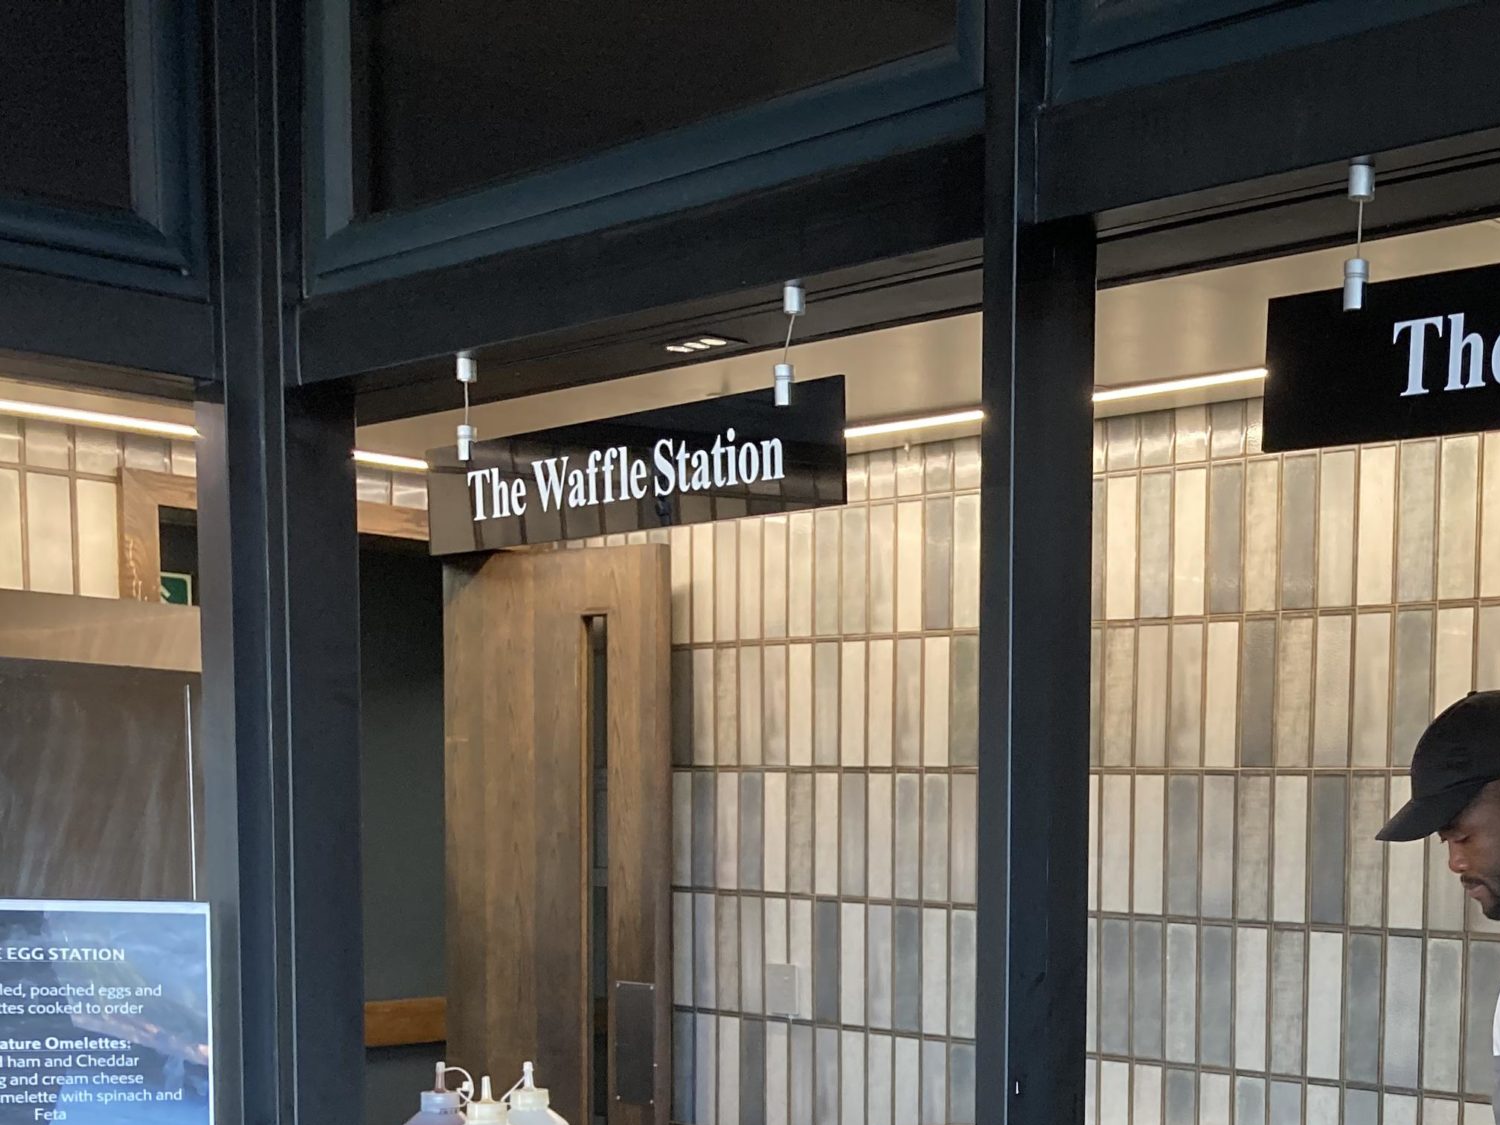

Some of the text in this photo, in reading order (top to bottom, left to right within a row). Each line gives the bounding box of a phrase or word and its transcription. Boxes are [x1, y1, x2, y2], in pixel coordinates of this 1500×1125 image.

[467, 427, 786, 522] The Waffle Station
[6, 946, 45, 961] EGG
[48, 947, 125, 962] STATION
[30, 983, 95, 1000] poached
[98, 985, 132, 1000] eggs
[135, 983, 162, 997] and
[28, 1001, 82, 1015] cooked
[86, 1002, 101, 1014] to
[104, 1001, 144, 1014] order
[45, 1036, 132, 1051] Omelettes:
[7, 1054, 41, 1068] ham
[44, 1054, 73, 1068] and
[76, 1053, 140, 1068] Cheddar
[9, 1072, 38, 1086] and
[42, 1073, 89, 1086] cream
[92, 1071, 144, 1085] cheese
[61, 1089, 93, 1103] with
[96, 1088, 152, 1105] spinach
[155, 1088, 183, 1101] and
[34, 1107, 67, 1121] Feta
